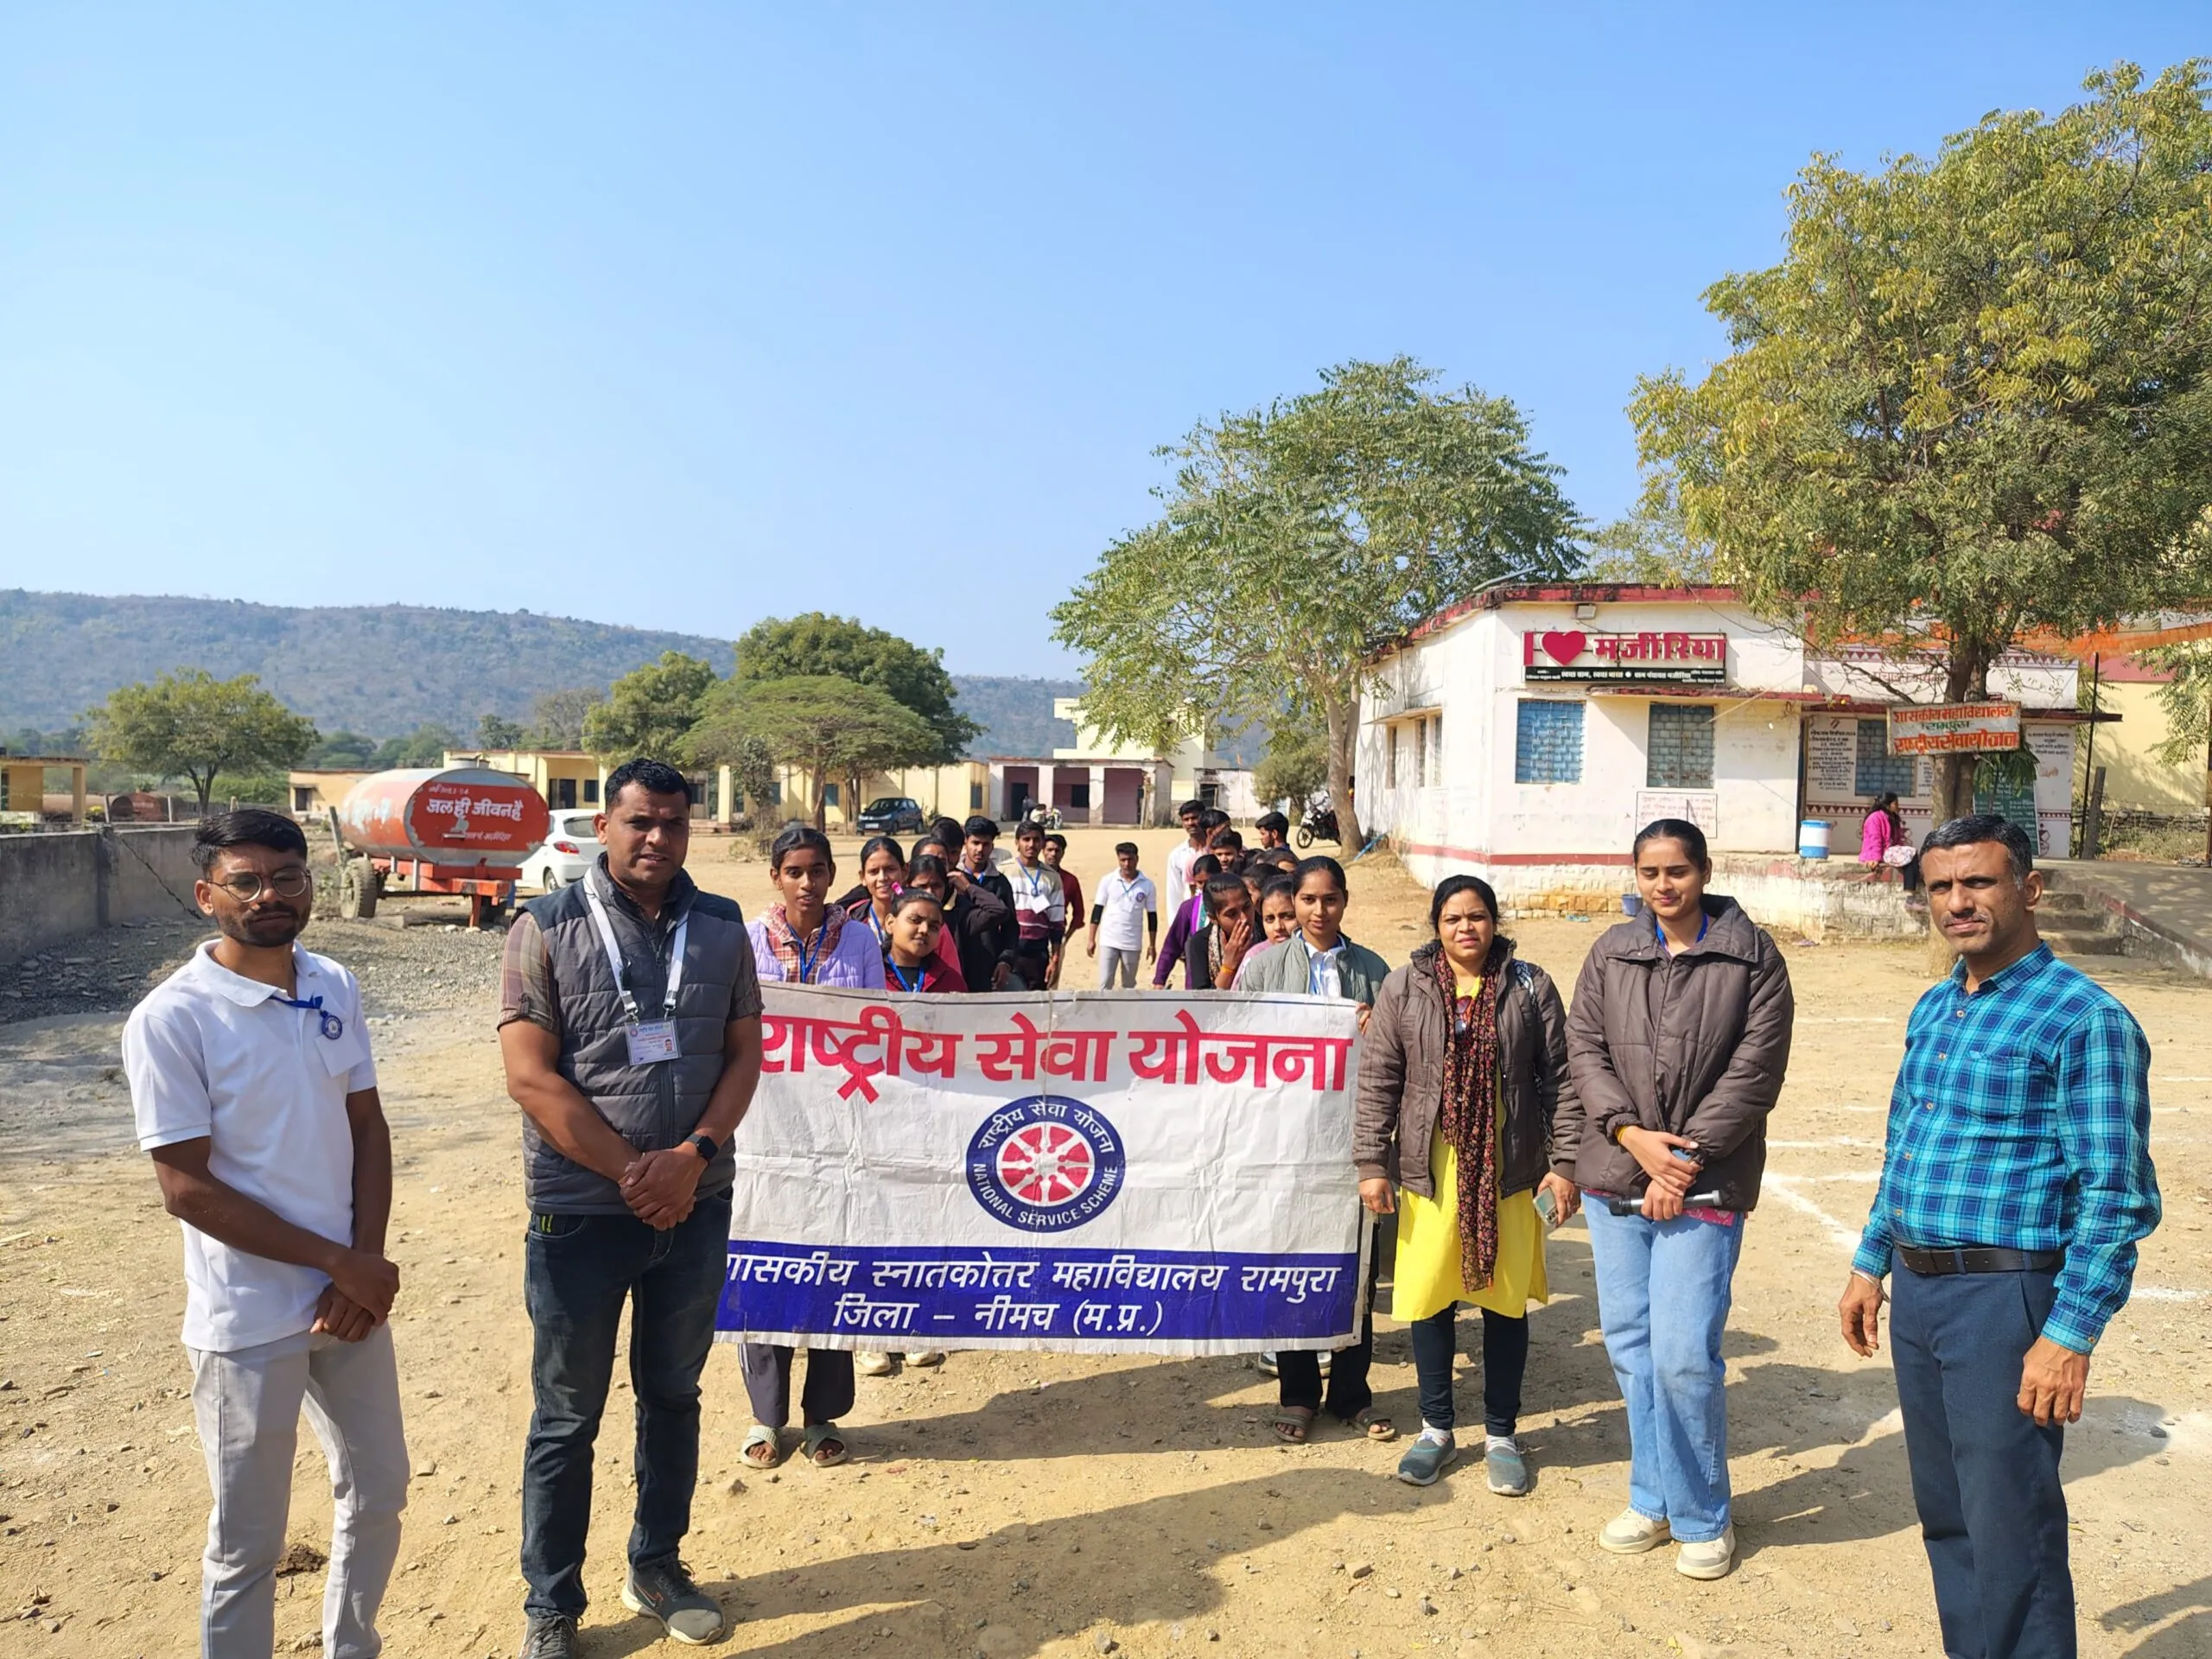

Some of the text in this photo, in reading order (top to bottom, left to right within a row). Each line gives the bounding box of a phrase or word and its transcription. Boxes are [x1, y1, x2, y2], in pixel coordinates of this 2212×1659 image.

[1592, 632, 1727, 661] मजीरिया
[761, 1005, 1353, 1104] राष्ट्रीय सेवा योजना
[978, 1100, 1116, 1154] राष्ट्रीय सेवा योजना
[972, 1163, 1118, 1227] NATIONAL SERVICE SCHEME
[872, 1251, 1041, 1288] स्नातकोत्तर
[1052, 1255, 1230, 1292] महाविद्यालय
[1240, 1267, 1342, 1304] रामपुरा
[832, 1294, 920, 1330] जिला
[975, 1295, 1060, 1331] नीमच
[1072, 1299, 1163, 1337] (म.प्र.)
